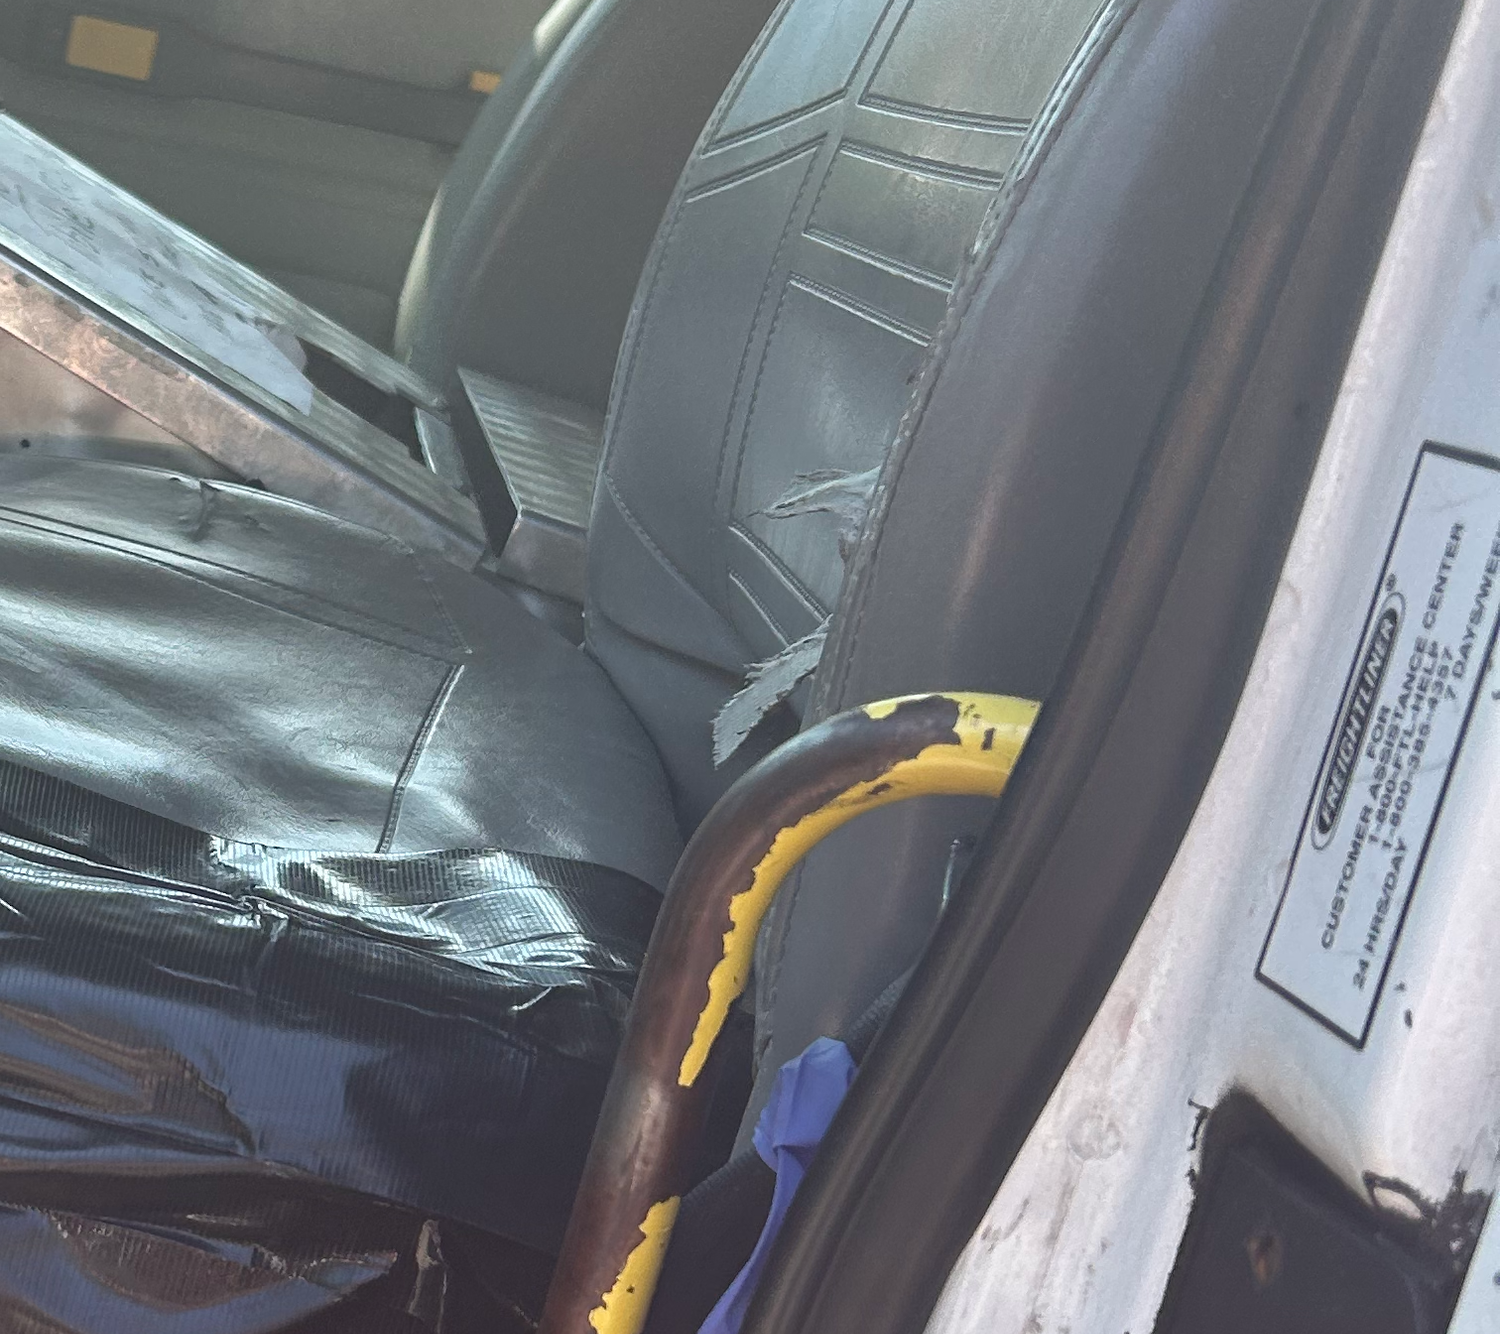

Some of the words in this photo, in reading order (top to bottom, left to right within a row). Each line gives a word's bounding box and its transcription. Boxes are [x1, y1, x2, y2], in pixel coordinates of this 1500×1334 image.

[1452, 520, 1500, 680] DAYS/WEE
[1319, 617, 1397, 828] FREIGHTLINER
[1321, 805, 1374, 950] CUSTOMER
[1368, 636, 1429, 800] ASSISTANCE
[1422, 522, 1465, 629] CENTER
[1366, 704, 1391, 759] FOR
